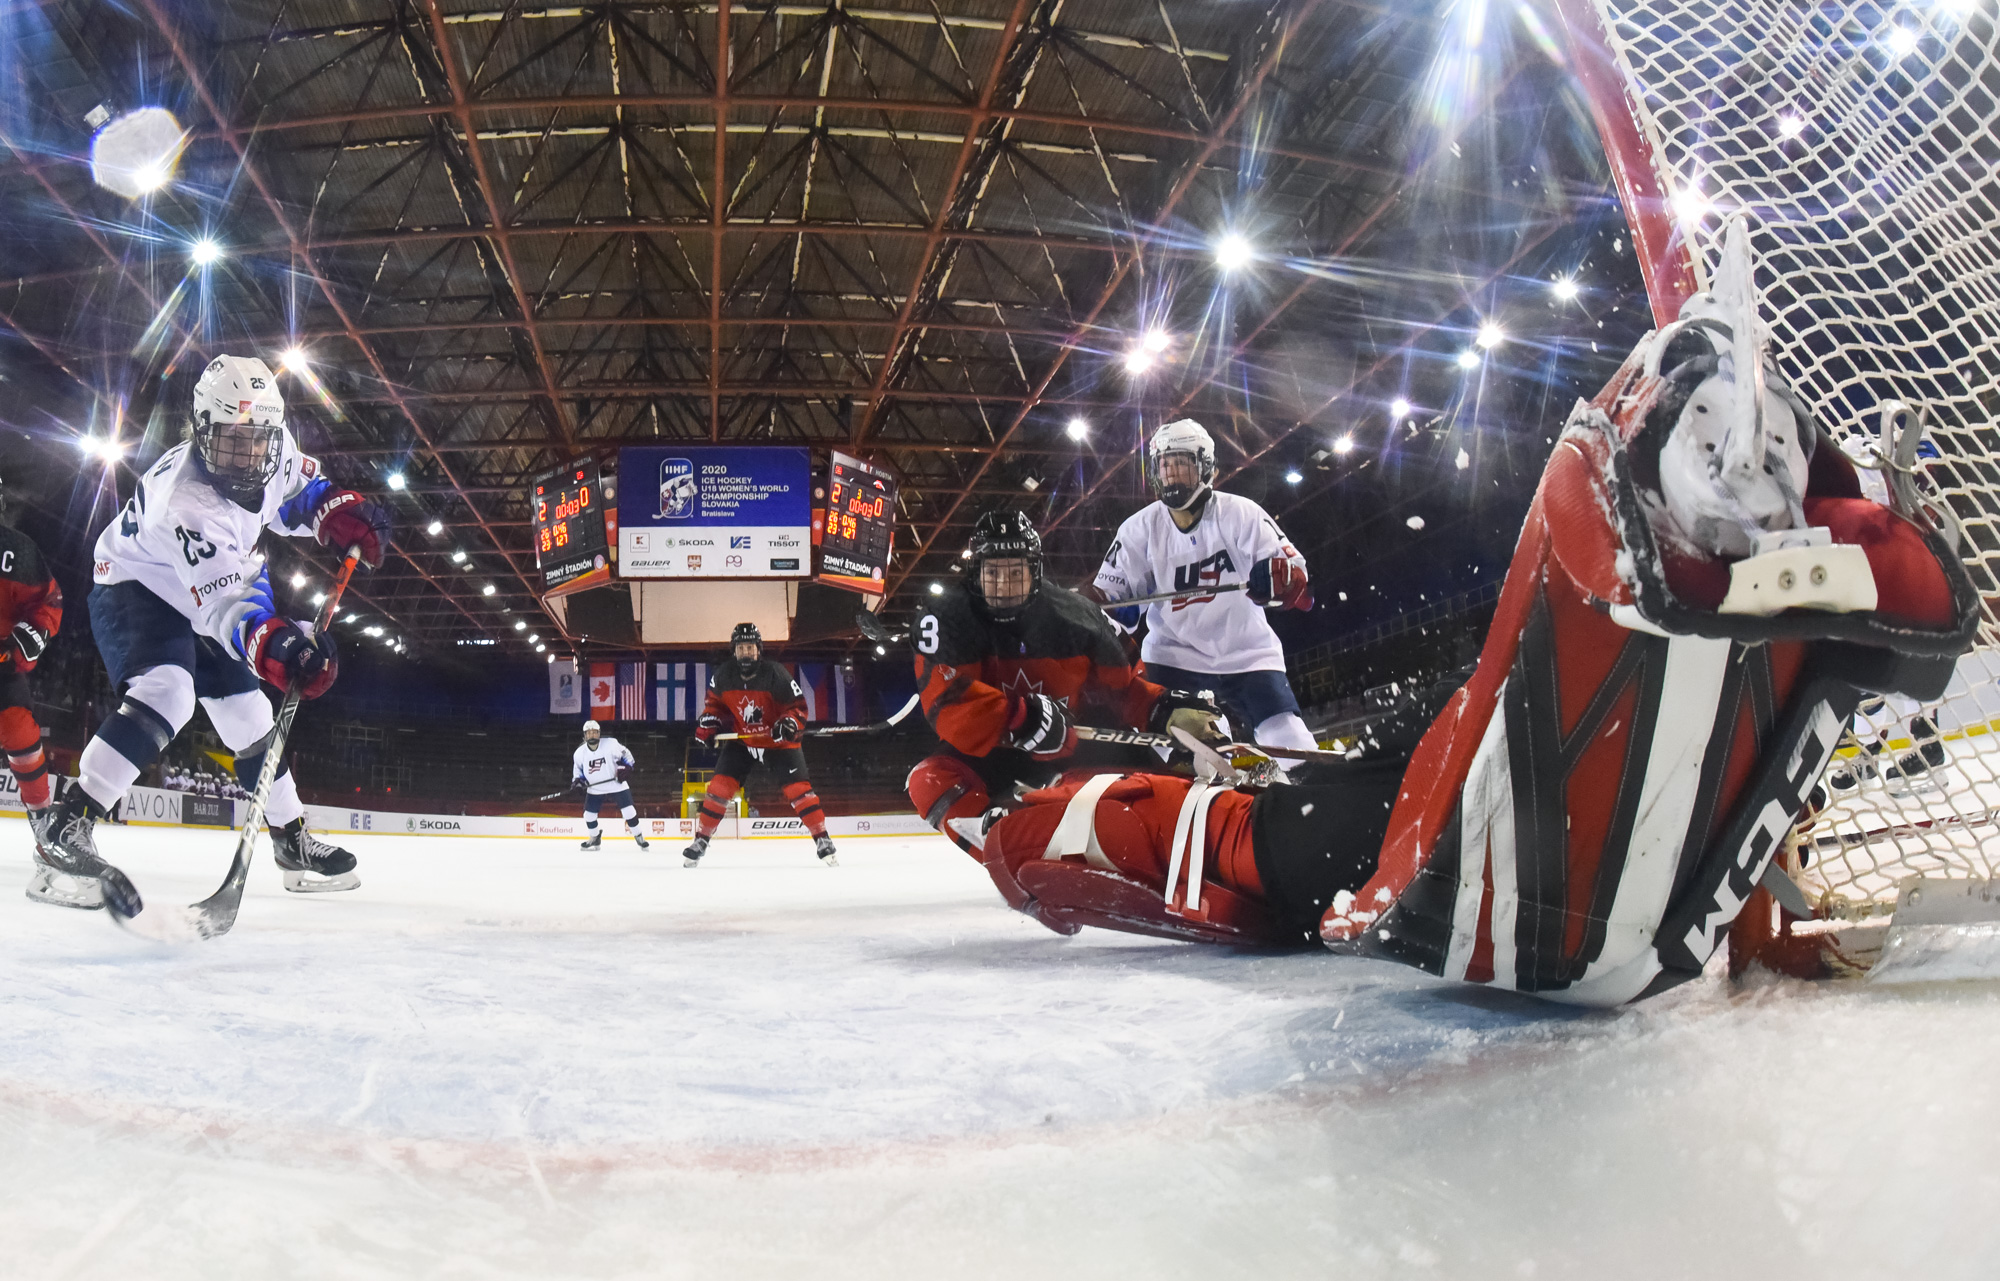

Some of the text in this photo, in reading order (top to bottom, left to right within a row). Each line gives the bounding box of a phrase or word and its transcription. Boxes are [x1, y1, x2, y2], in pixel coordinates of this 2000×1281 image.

[250, 377, 266, 390] 25
[255, 404, 278, 413] TOYOTA
[665, 465, 688, 474] IIHF
[701, 465, 727, 474] 2020
[560, 491, 566, 504] 3
[580, 486, 590, 508] 0
[701, 493, 769, 501] CHAMPIONSHIP
[831, 483, 842, 504] 2
[856, 488, 863, 500] 3
[538, 501, 547, 522] 2
[555, 498, 580, 519] 00:03
[848, 497, 874, 518] 00:03
[873, 497, 884, 517] 0
[312, 493, 355, 538] AUER
[828, 510, 839, 523] 26
[541, 528, 550, 541] 26
[827, 522, 838, 535] 23
[1000, 524, 1007, 534] 3
[541, 539, 551, 552] 23
[678, 538, 715, 546] ŠKODA
[768, 540, 800, 548] TISSOT
[994, 541, 1027, 550] TELUS
[1, 550, 15, 573] C
[823, 554, 871, 575] ZIMNÝ ŠTADIÓN
[546, 565, 564, 580] ZIMNÝ
[565, 558, 592, 575] ŠTADIÓN
[1173, 549, 1236, 592] USA
[198, 572, 242, 597] TOYOTA
[918, 614, 940, 654] 3
[588, 757, 607, 769] USA
[238, 749, 281, 849] BAUER
[126, 793, 180, 819] AVON
[193, 803, 219, 816] BAR ZUZ
[420, 818, 461, 830] ŠKODA
[539, 826, 573, 834] Kaufland
[1683, 698, 1850, 967] CCM
